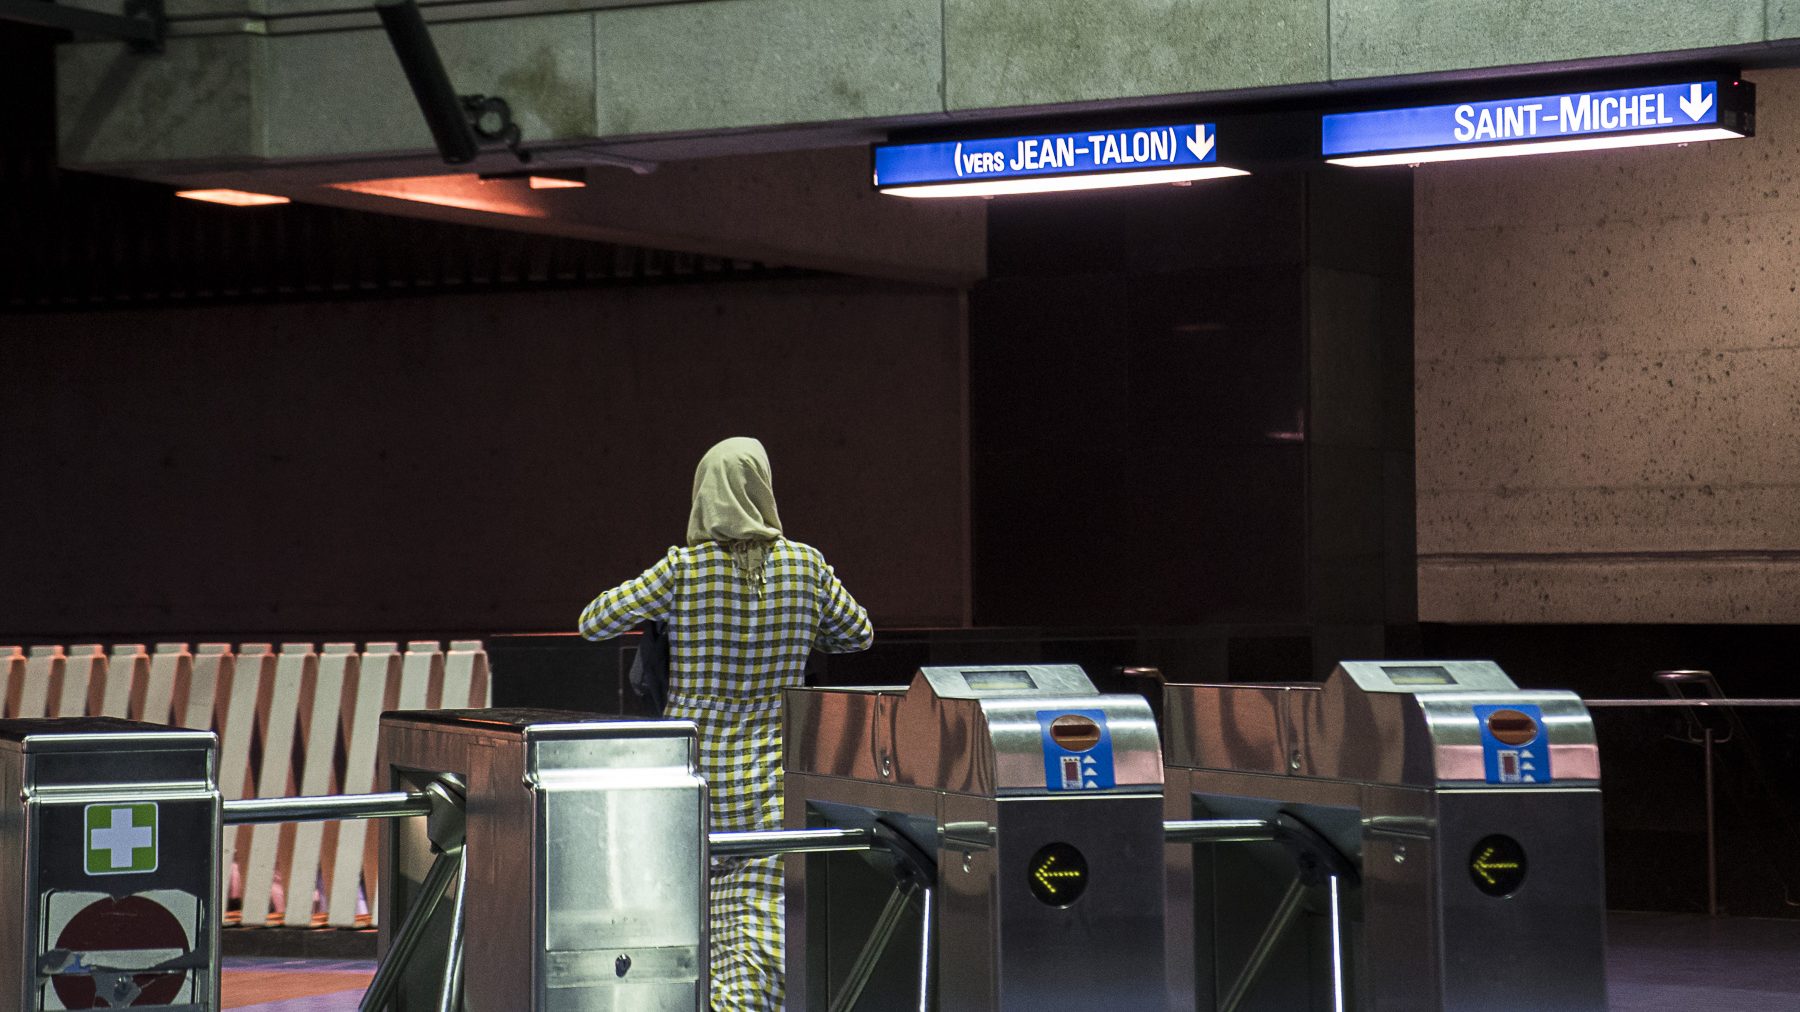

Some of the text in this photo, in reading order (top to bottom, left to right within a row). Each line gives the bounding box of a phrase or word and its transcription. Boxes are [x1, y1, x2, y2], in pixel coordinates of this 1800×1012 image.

[1454, 94, 1673, 142] SAINT-MICHEL
[954, 127, 1177, 176] (VERS JEAN-TALON)
